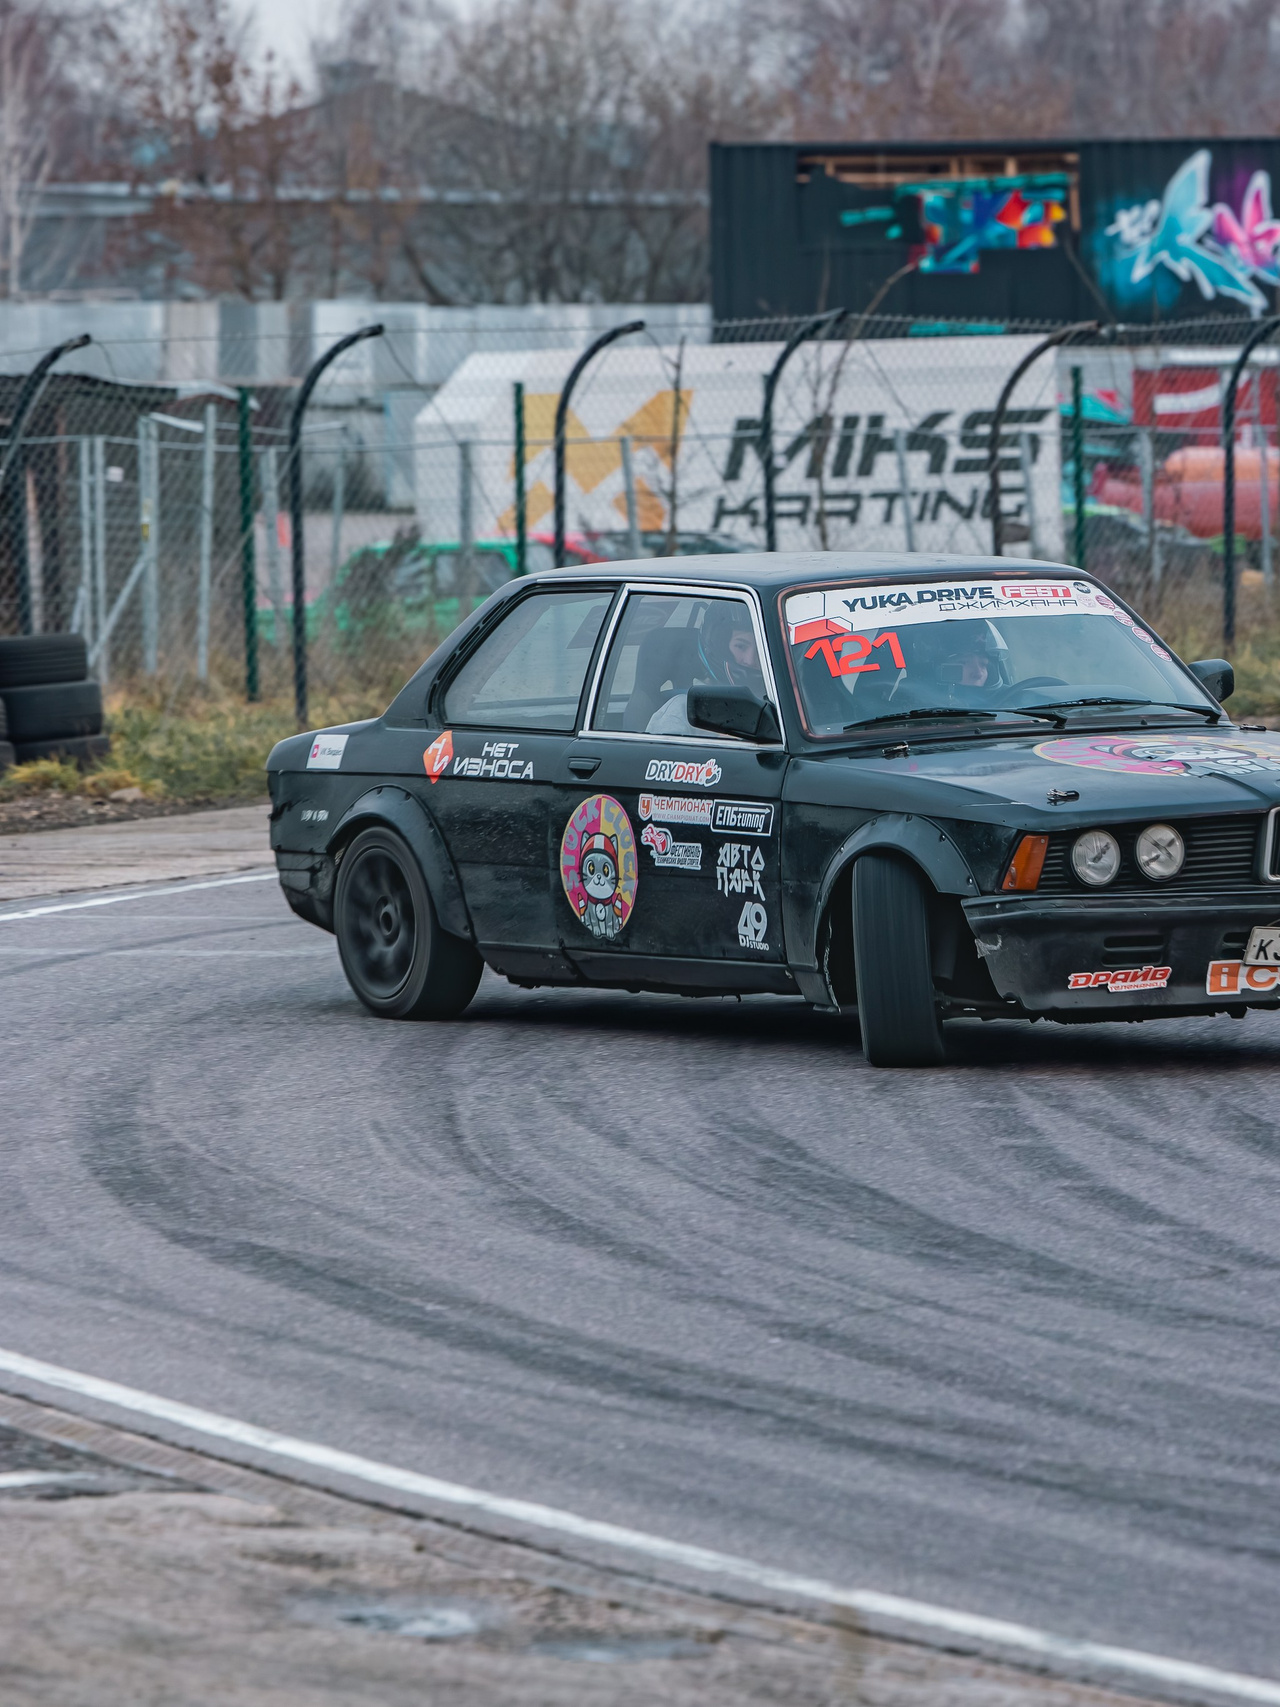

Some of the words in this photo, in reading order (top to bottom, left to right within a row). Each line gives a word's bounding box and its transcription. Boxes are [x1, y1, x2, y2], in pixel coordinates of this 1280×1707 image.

[724, 409, 1055, 481] MIKS
[711, 488, 1029, 529] KARTING
[842, 592, 914, 612] YUKA
[917, 586, 995, 604] DRIVE
[939, 599, 1078, 611] ДЖИМХАНА
[804, 632, 906, 678] 121
[481, 742, 520, 758] НЕТ
[453, 757, 534, 779] ИЗНОСА
[654, 799, 713, 814] ЧЕМПИОНАТ
[562, 798, 600, 892] STOCK
[604, 799, 635, 899] CLOCK
[737, 901, 768, 942] 49
[1071, 967, 1171, 987] ДРАЙВ
